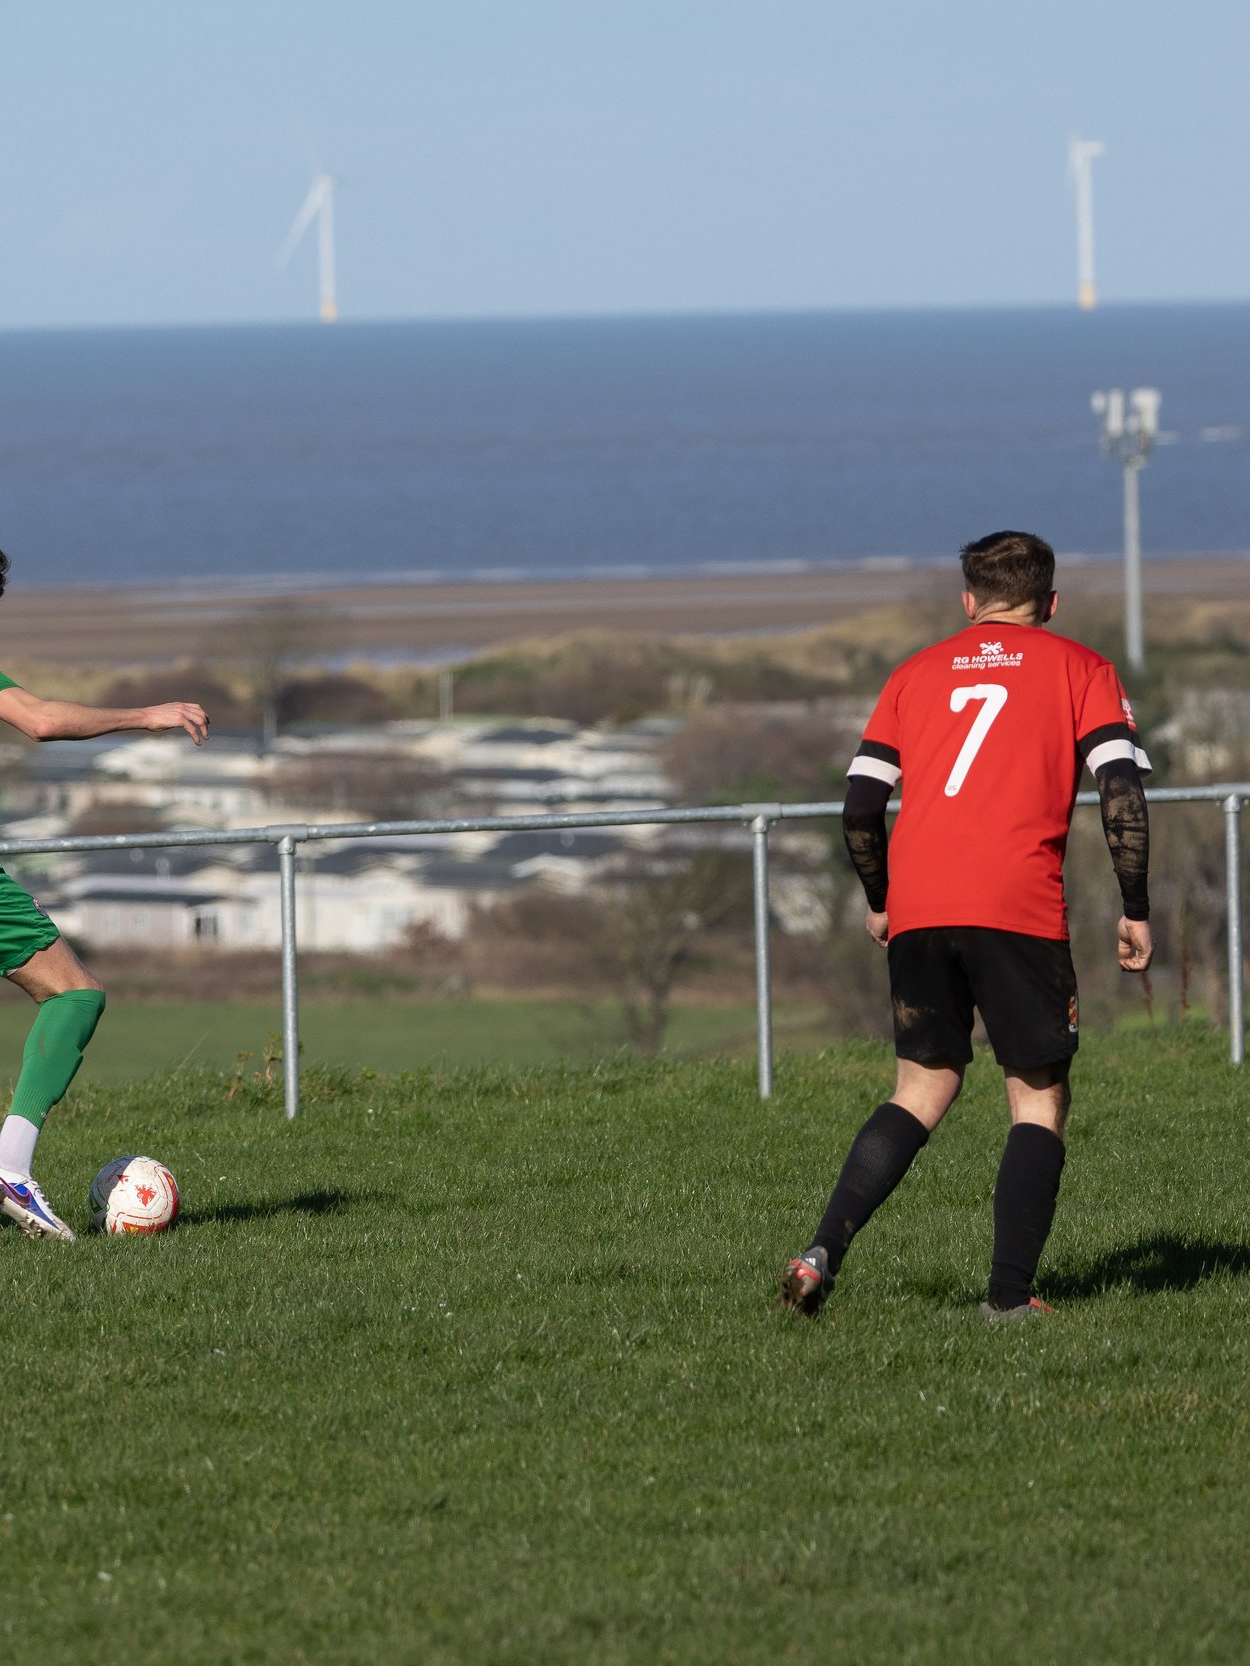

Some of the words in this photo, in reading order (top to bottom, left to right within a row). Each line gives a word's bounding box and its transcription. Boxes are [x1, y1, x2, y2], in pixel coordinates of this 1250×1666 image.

[952, 662, 986, 670] cleaning
[987, 660, 1021, 668] services
[953, 656, 970, 665] RG
[972, 652, 1023, 663] HOWELLS
[944, 683, 1008, 797] 7
